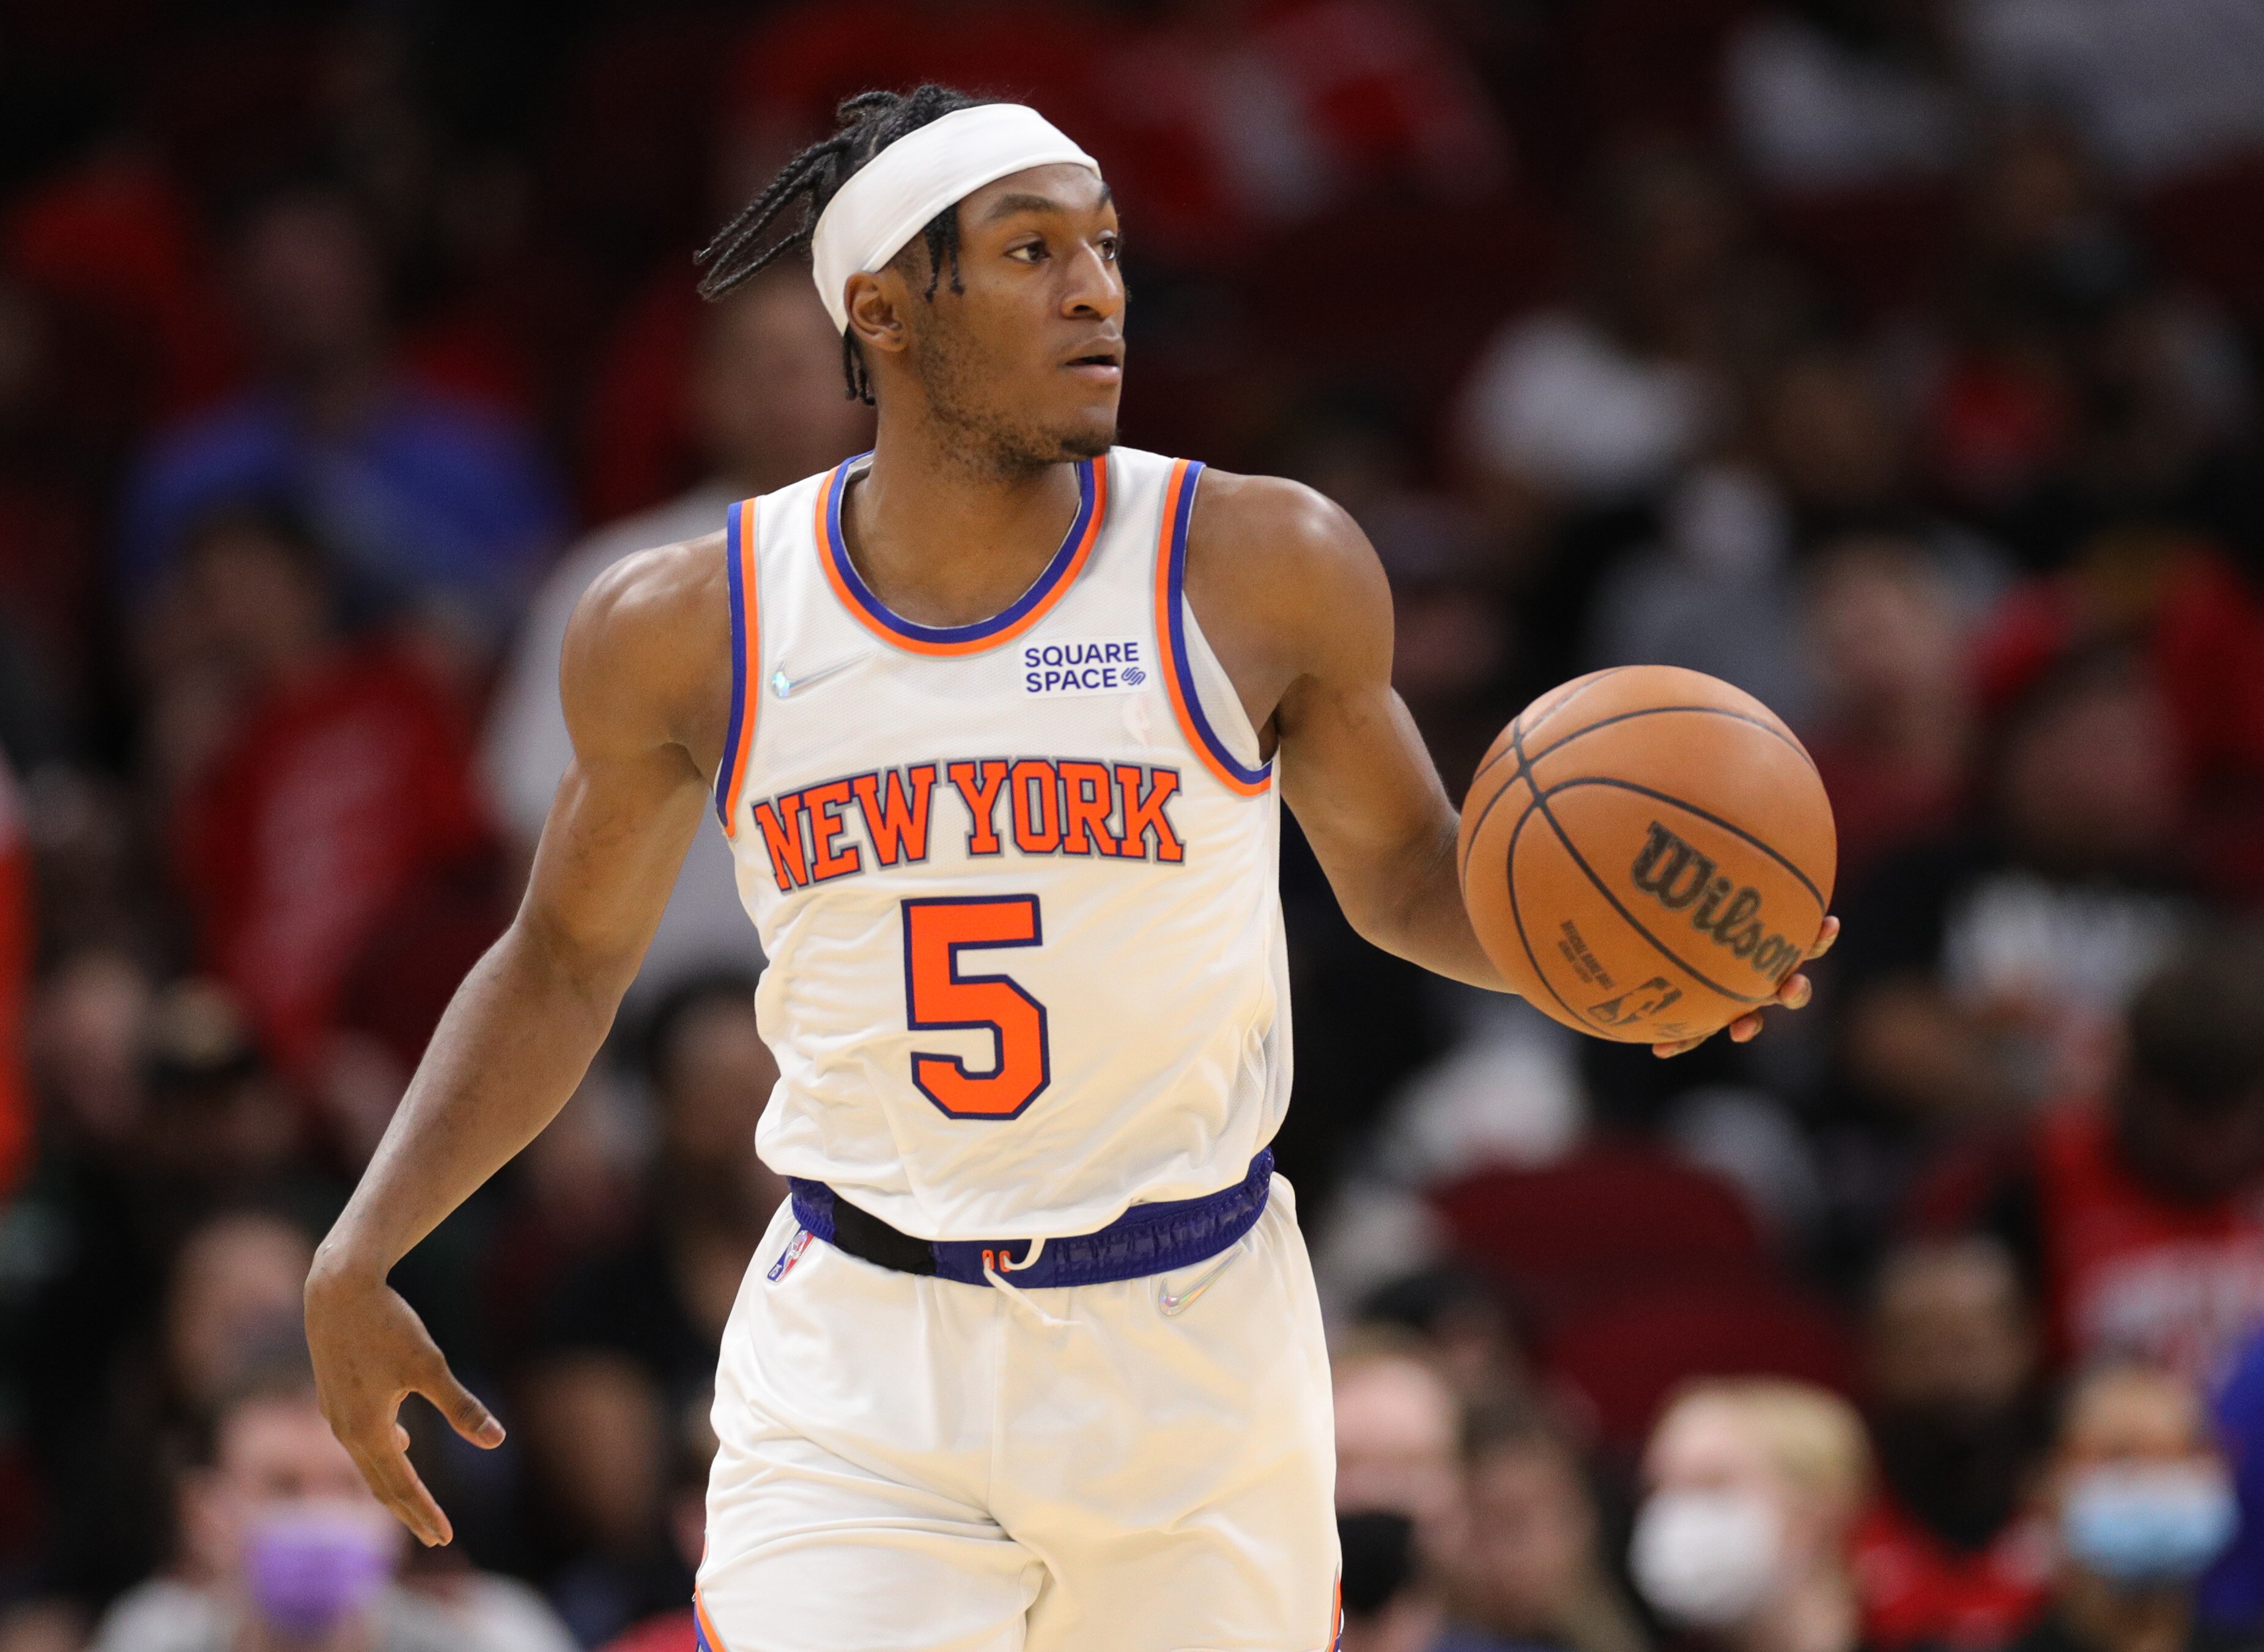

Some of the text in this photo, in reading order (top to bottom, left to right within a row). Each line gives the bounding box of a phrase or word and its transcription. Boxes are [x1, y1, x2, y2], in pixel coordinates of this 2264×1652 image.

[1025, 642, 1139, 668] SQUARE
[1026, 668, 1118, 693] SPACE
[752, 758, 1186, 893] NEW YORK
[1631, 820, 1802, 987] Wilson
[901, 893, 1051, 1120] 5
